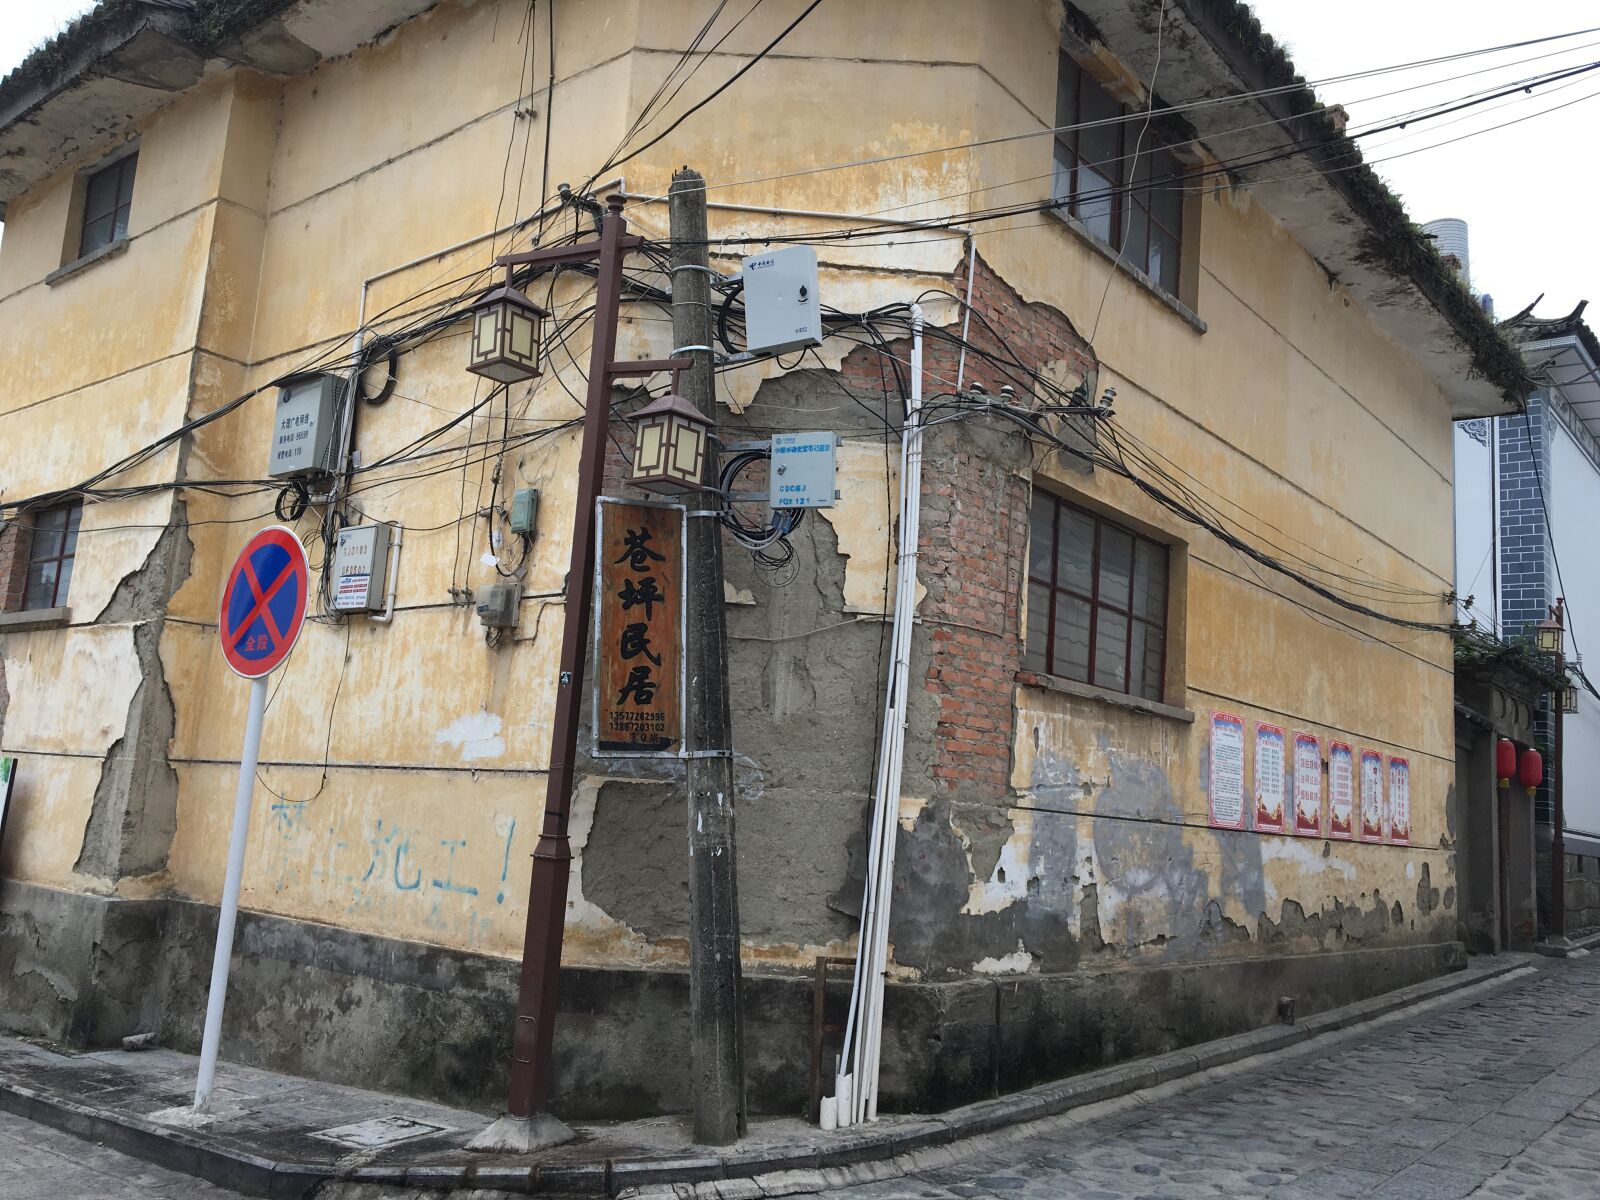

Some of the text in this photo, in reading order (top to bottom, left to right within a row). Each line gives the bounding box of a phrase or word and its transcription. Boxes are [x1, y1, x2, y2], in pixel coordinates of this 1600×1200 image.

[280, 413, 310, 431] 大理广电网络
[244, 634, 269, 651] 全段
[609, 711, 666, 722] 13577262996
[609, 722, 666, 733] 13887203102
